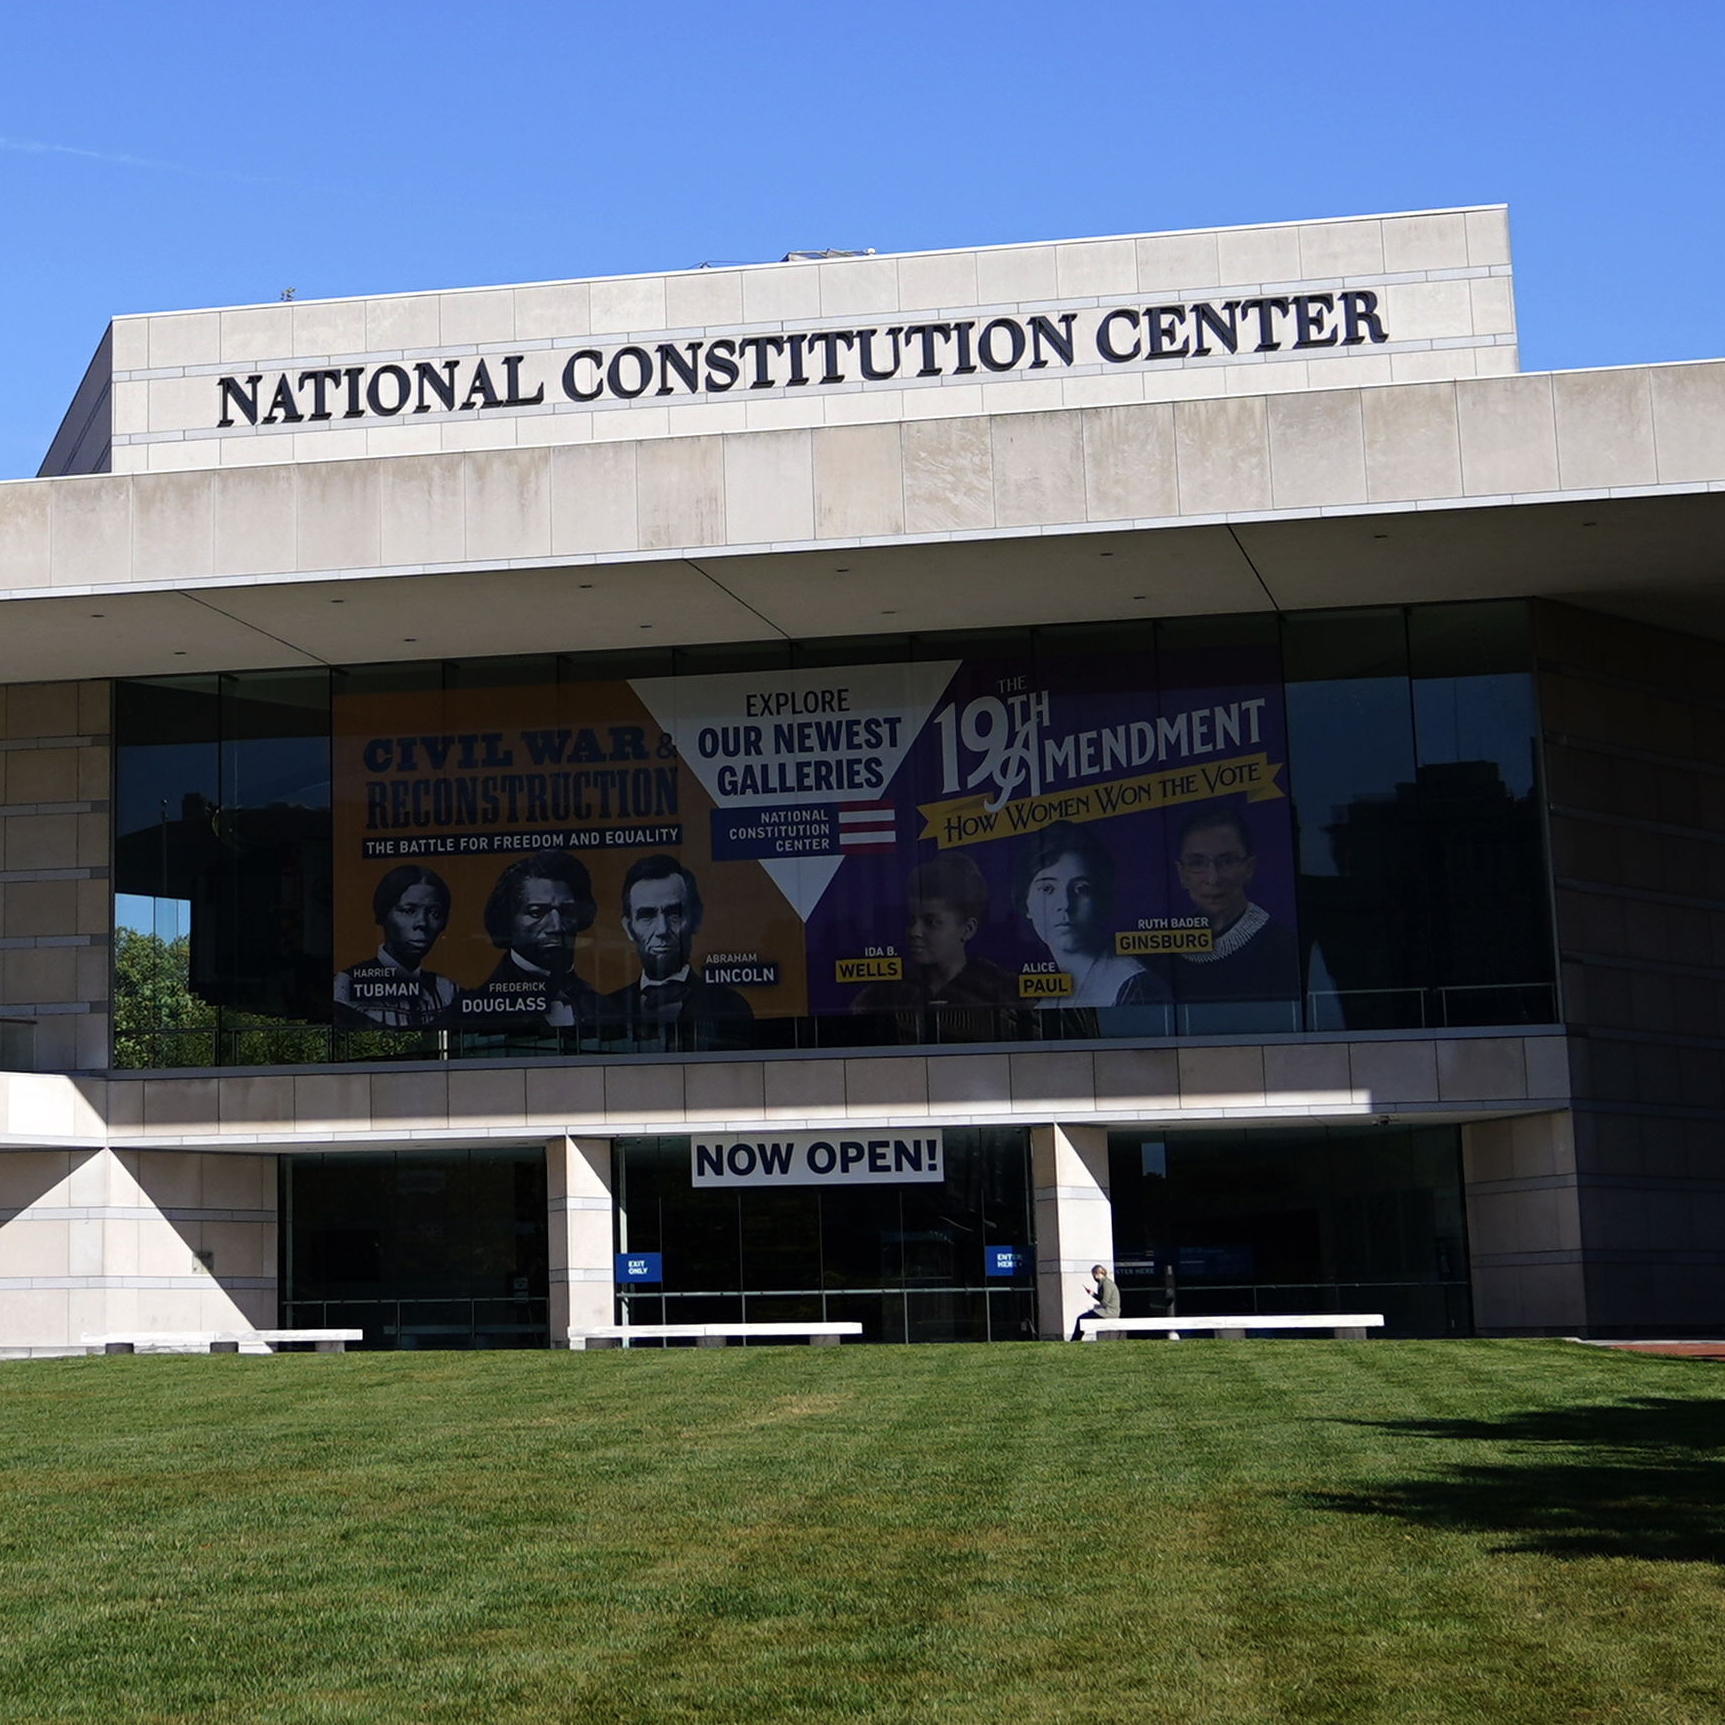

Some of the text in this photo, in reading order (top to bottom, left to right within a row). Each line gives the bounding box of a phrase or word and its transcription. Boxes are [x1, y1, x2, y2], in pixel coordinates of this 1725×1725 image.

[216, 290, 1390, 428] NATIONAL CONSTITUTION CENTER
[996, 675, 1027, 693] THE
[746, 689, 850, 717] EXPLORE
[698, 717, 902, 759] OUR NEWEST
[363, 726, 678, 773] CIVIL WAR &
[933, 689, 1266, 813] 19TH AMENDMENT
[717, 757, 884, 797] GALLERIES
[366, 767, 678, 830] RECONSTRUCTION
[944, 761, 1261, 844] HOW WOMEN WON THE VOTE
[760, 808, 829, 824] NATIONAL
[729, 823, 830, 841] CONSTITUTION
[366, 827, 679, 855] THE BATTLE FOR FREEDOM AND EQUALITY
[775, 837, 830, 853] CENTER
[1138, 917, 1209, 930] RUTH BADER
[1120, 934, 1209, 950] GINSBURG
[705, 953, 758, 964] ABRAHAM
[864, 946, 898, 957] IDA B.
[353, 967, 397, 979] HARRIET
[705, 967, 775, 984] LINCOLN
[839, 961, 898, 978] WELLS
[1022, 962, 1056, 974] ALICE
[353, 982, 420, 998] TUBMAN
[489, 981, 547, 993] FREDERICK
[1024, 978, 1068, 993] PAUL
[462, 997, 547, 1014] DOUGLASS
[696, 1139, 937, 1177] NOW OPEN!
[628, 1260, 646, 1268] EXIT
[628, 1267, 648, 1275] ONLY
